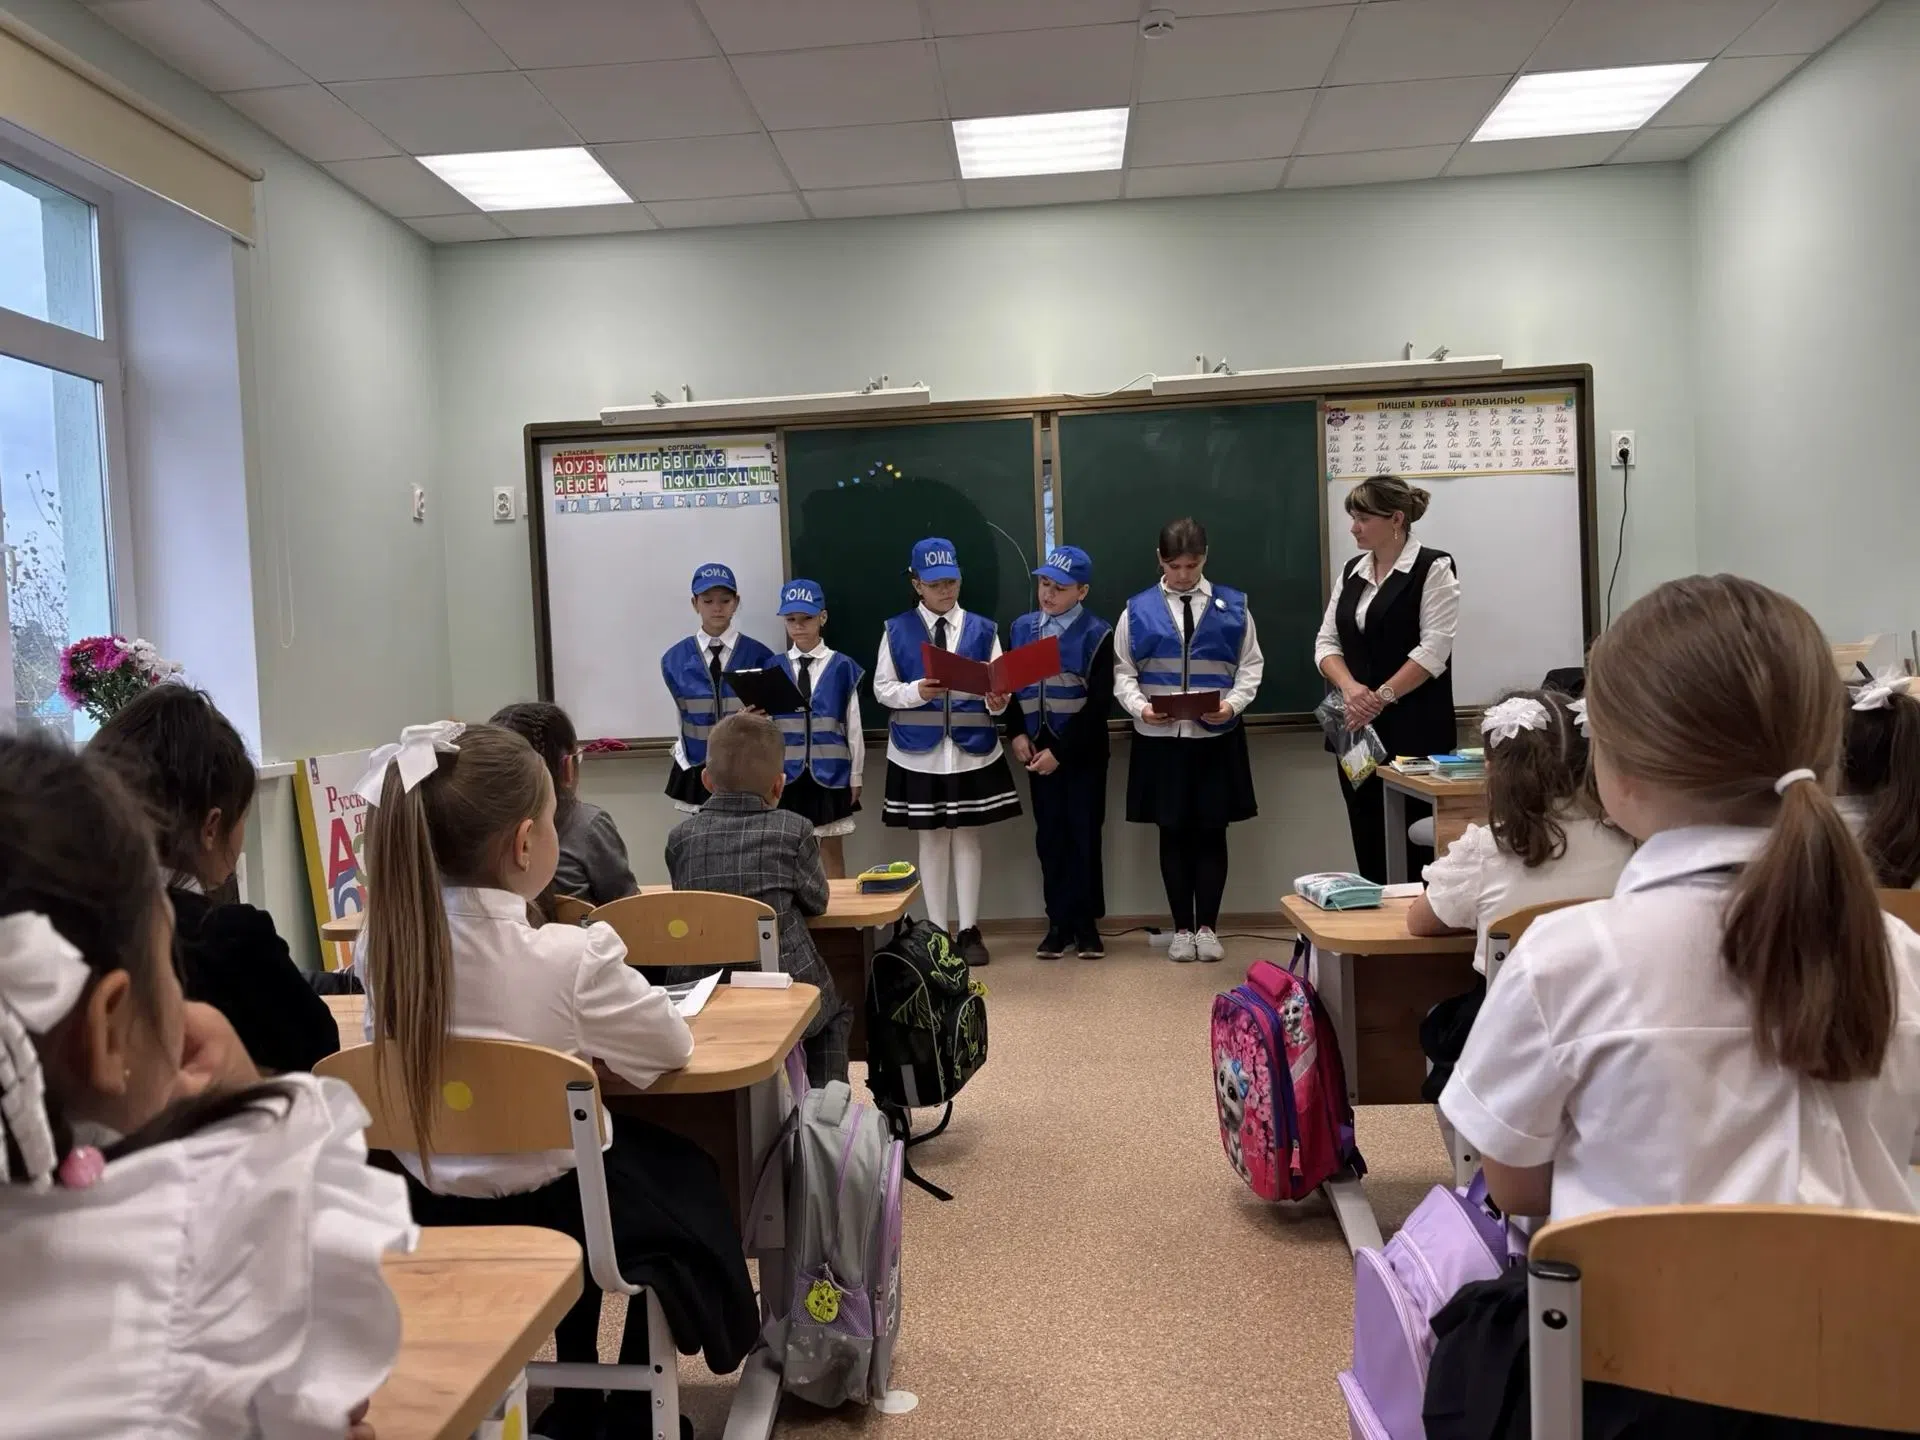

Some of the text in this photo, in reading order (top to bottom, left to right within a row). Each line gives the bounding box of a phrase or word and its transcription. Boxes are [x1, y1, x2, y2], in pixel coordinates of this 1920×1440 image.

[1377, 400, 1415, 410] ПИШЕМ
[1462, 396, 1525, 406] ПРАВИЛЬНО
[924, 551, 954, 566] ЮИД
[701, 567, 729, 579] ЮИД
[786, 588, 813, 602] ЮИД
